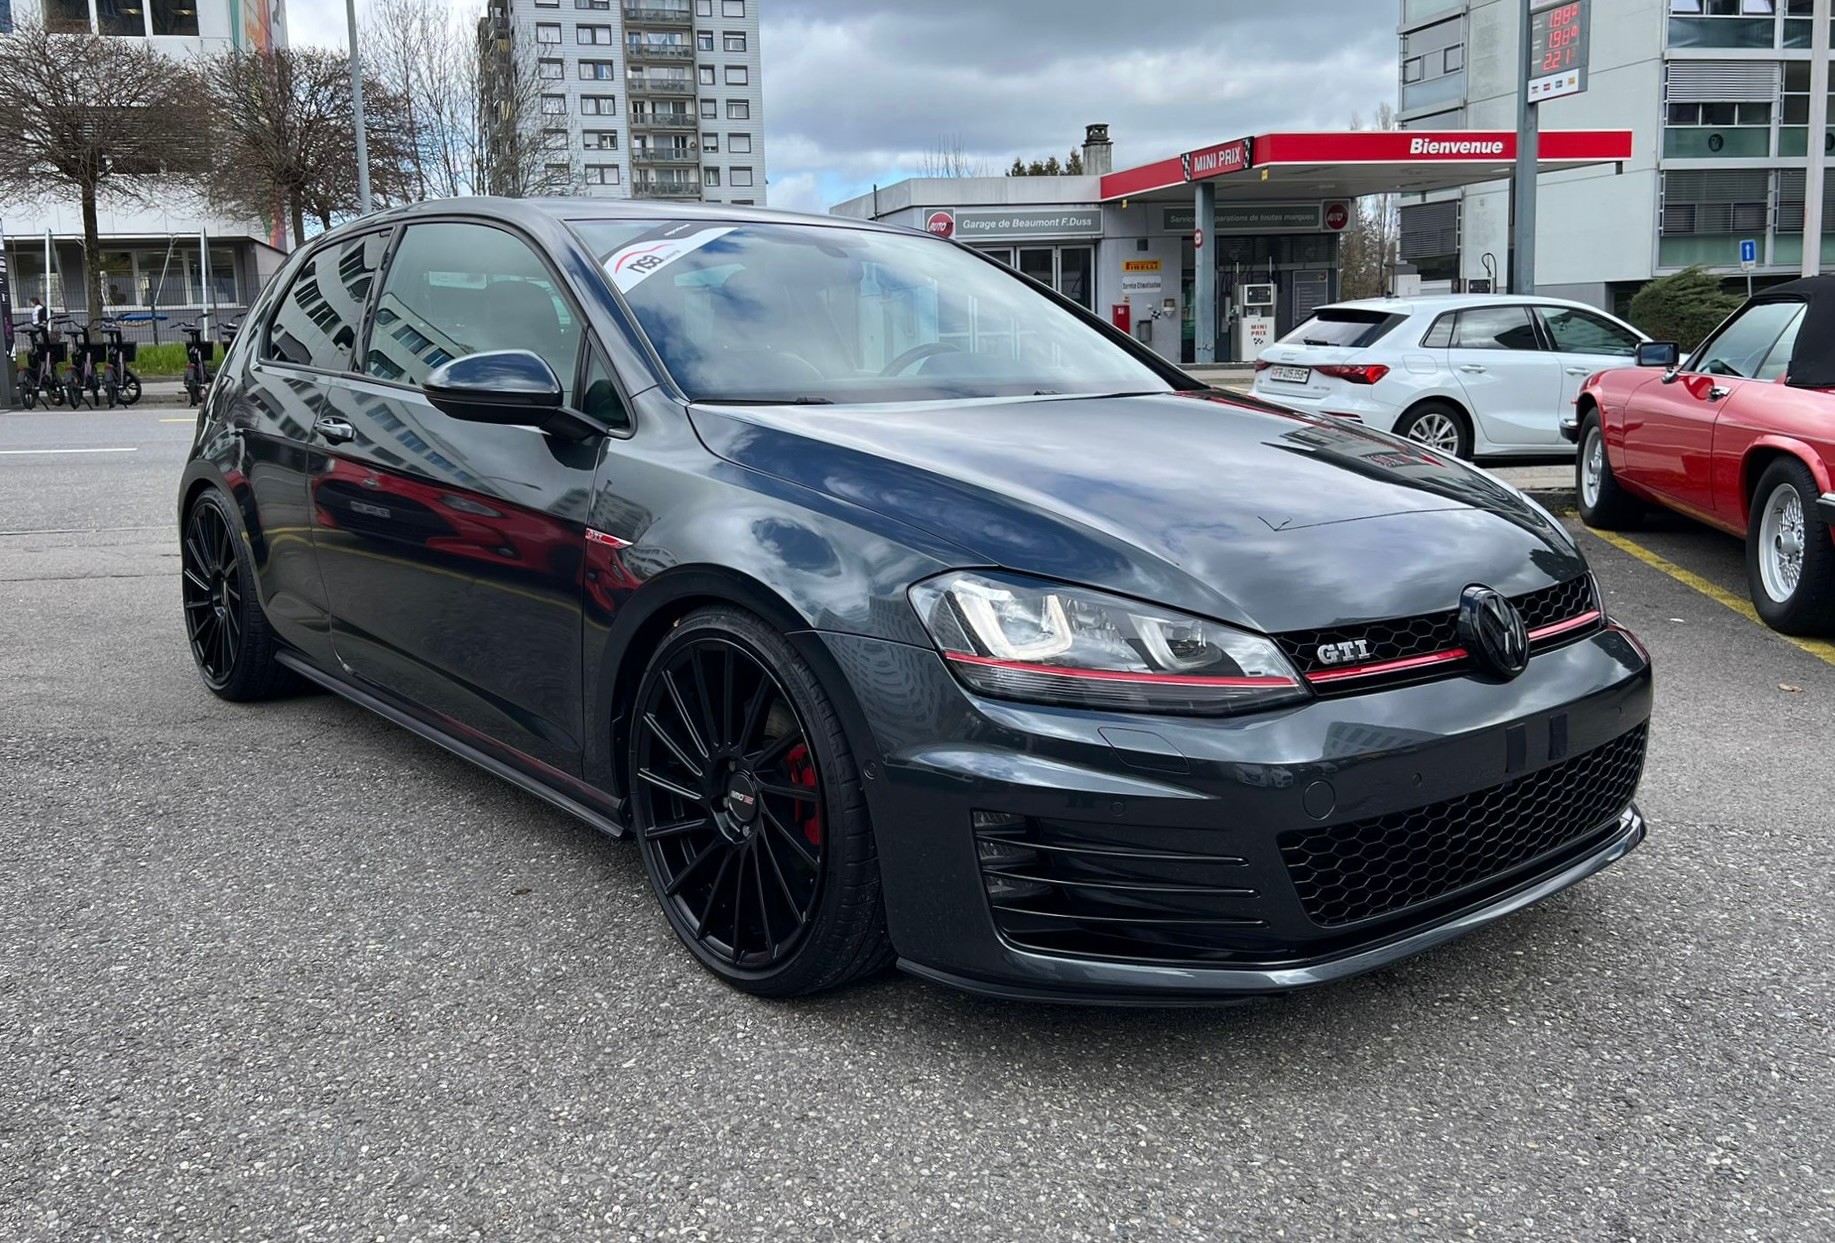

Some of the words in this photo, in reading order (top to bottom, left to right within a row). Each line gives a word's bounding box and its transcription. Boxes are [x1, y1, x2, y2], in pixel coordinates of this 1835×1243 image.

[1409, 138, 1504, 154] Bienvenue
[1194, 152, 1216, 173] MINI
[1218, 146, 1241, 167] PRIX
[963, 219, 996, 230] Garage
[998, 218, 1010, 229] de
[1012, 217, 1059, 228] Beaumont
[1061, 217, 1092, 227] F.Duss
[1250, 214, 1259, 222] de
[1260, 214, 1283, 222] toutes
[1284, 214, 1315, 223] marques
[585, 529, 603, 542] GTI
[1316, 639, 1371, 665] GTI
